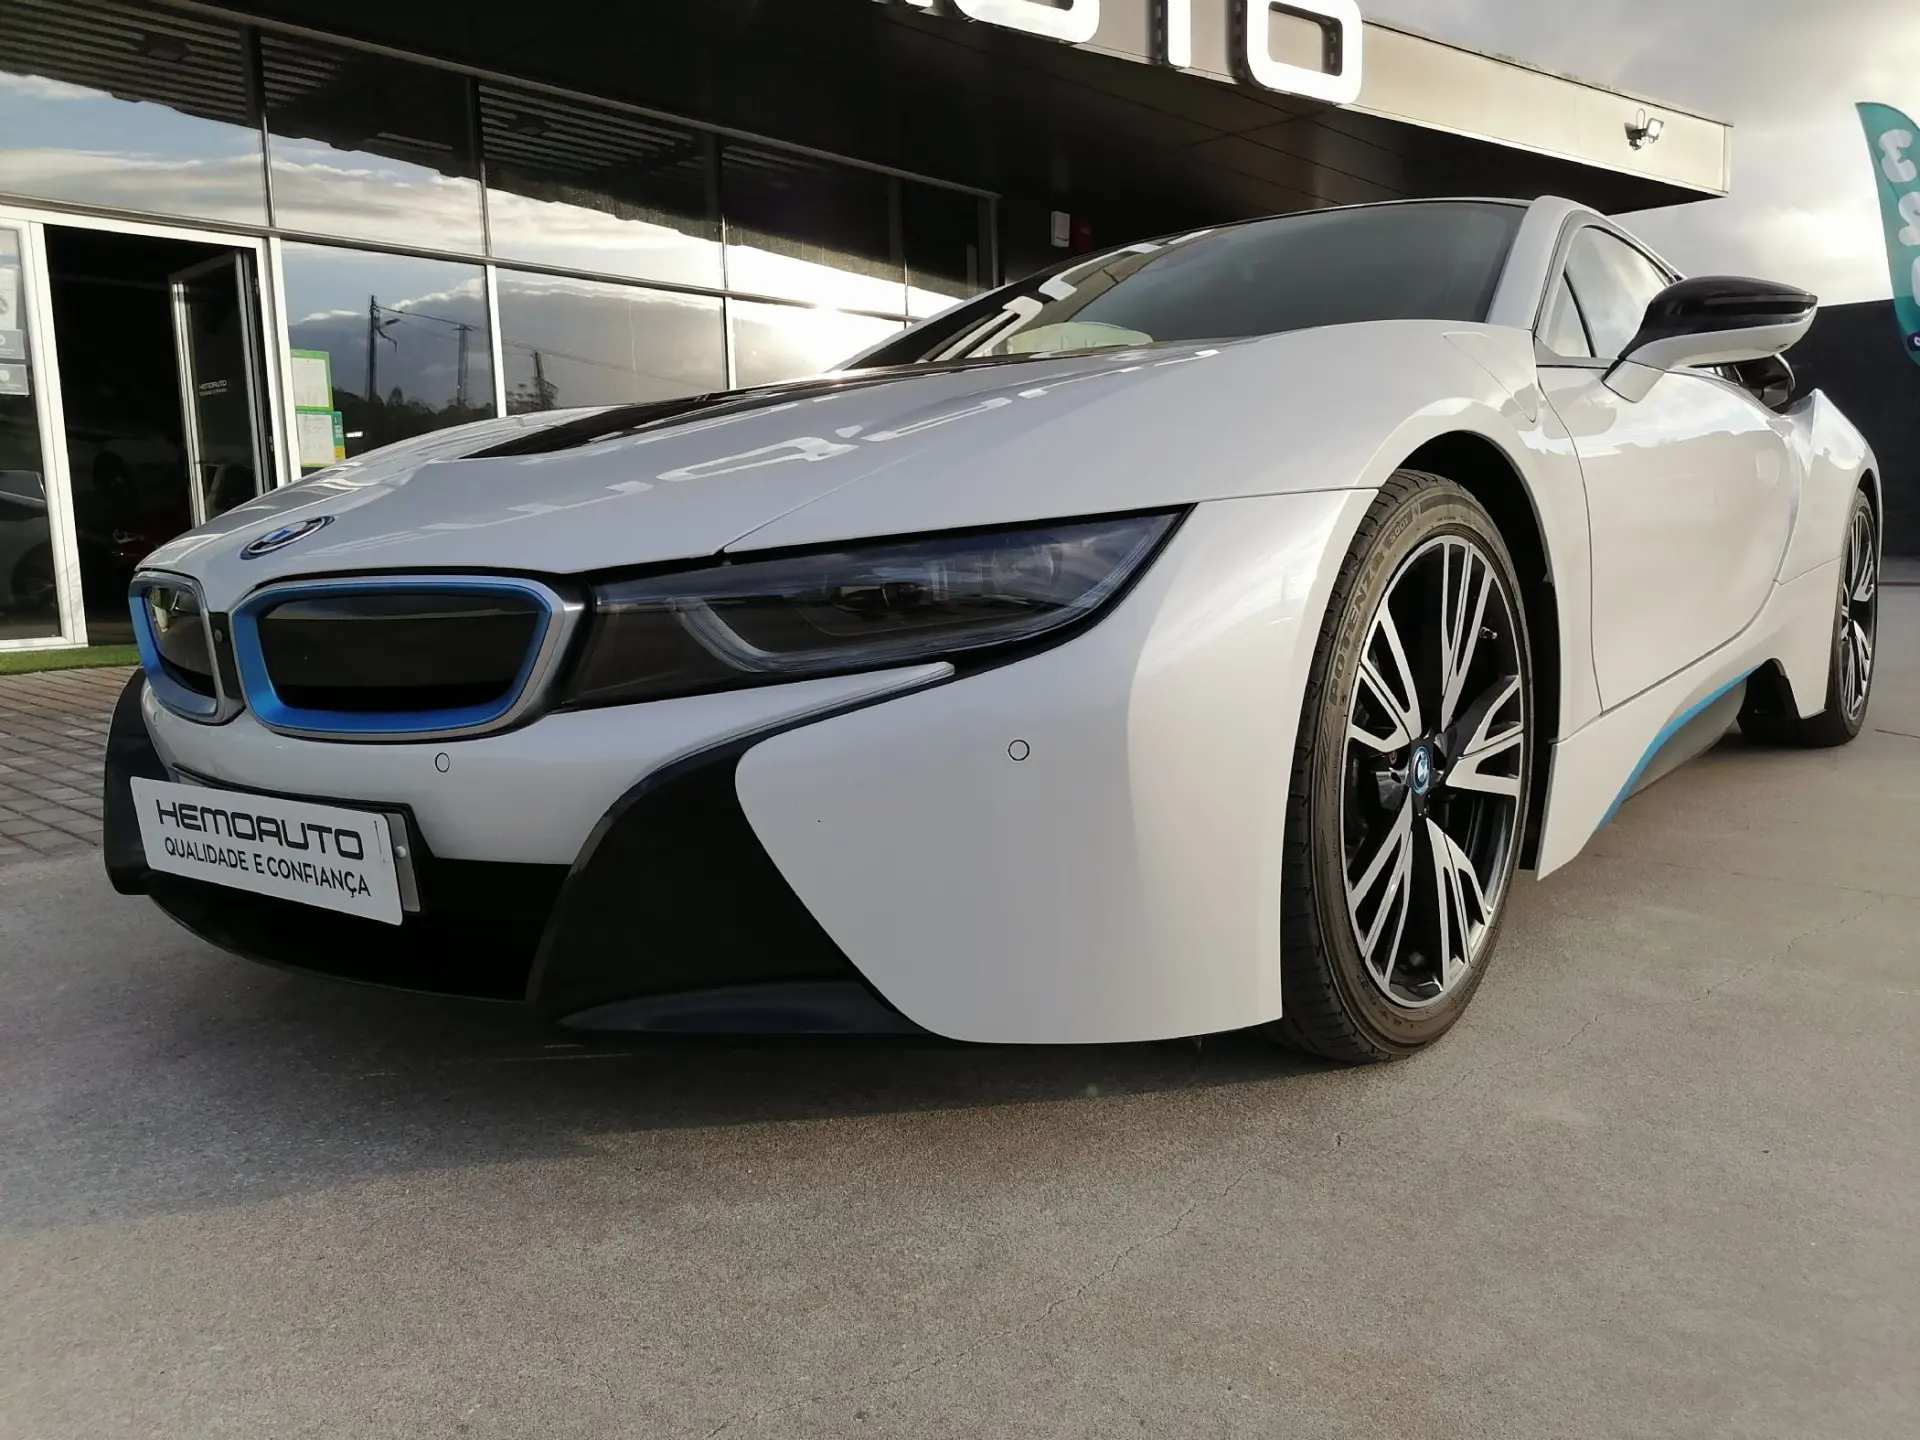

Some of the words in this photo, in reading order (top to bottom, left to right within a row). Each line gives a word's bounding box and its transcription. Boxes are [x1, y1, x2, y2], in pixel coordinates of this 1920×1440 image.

[1329, 551, 1386, 706] POTENZA
[155, 799, 364, 861] HEMOAUTO
[164, 836, 249, 871] QUALIDADE
[254, 853, 265, 874] E
[267, 858, 371, 898] CONFIANÇA
